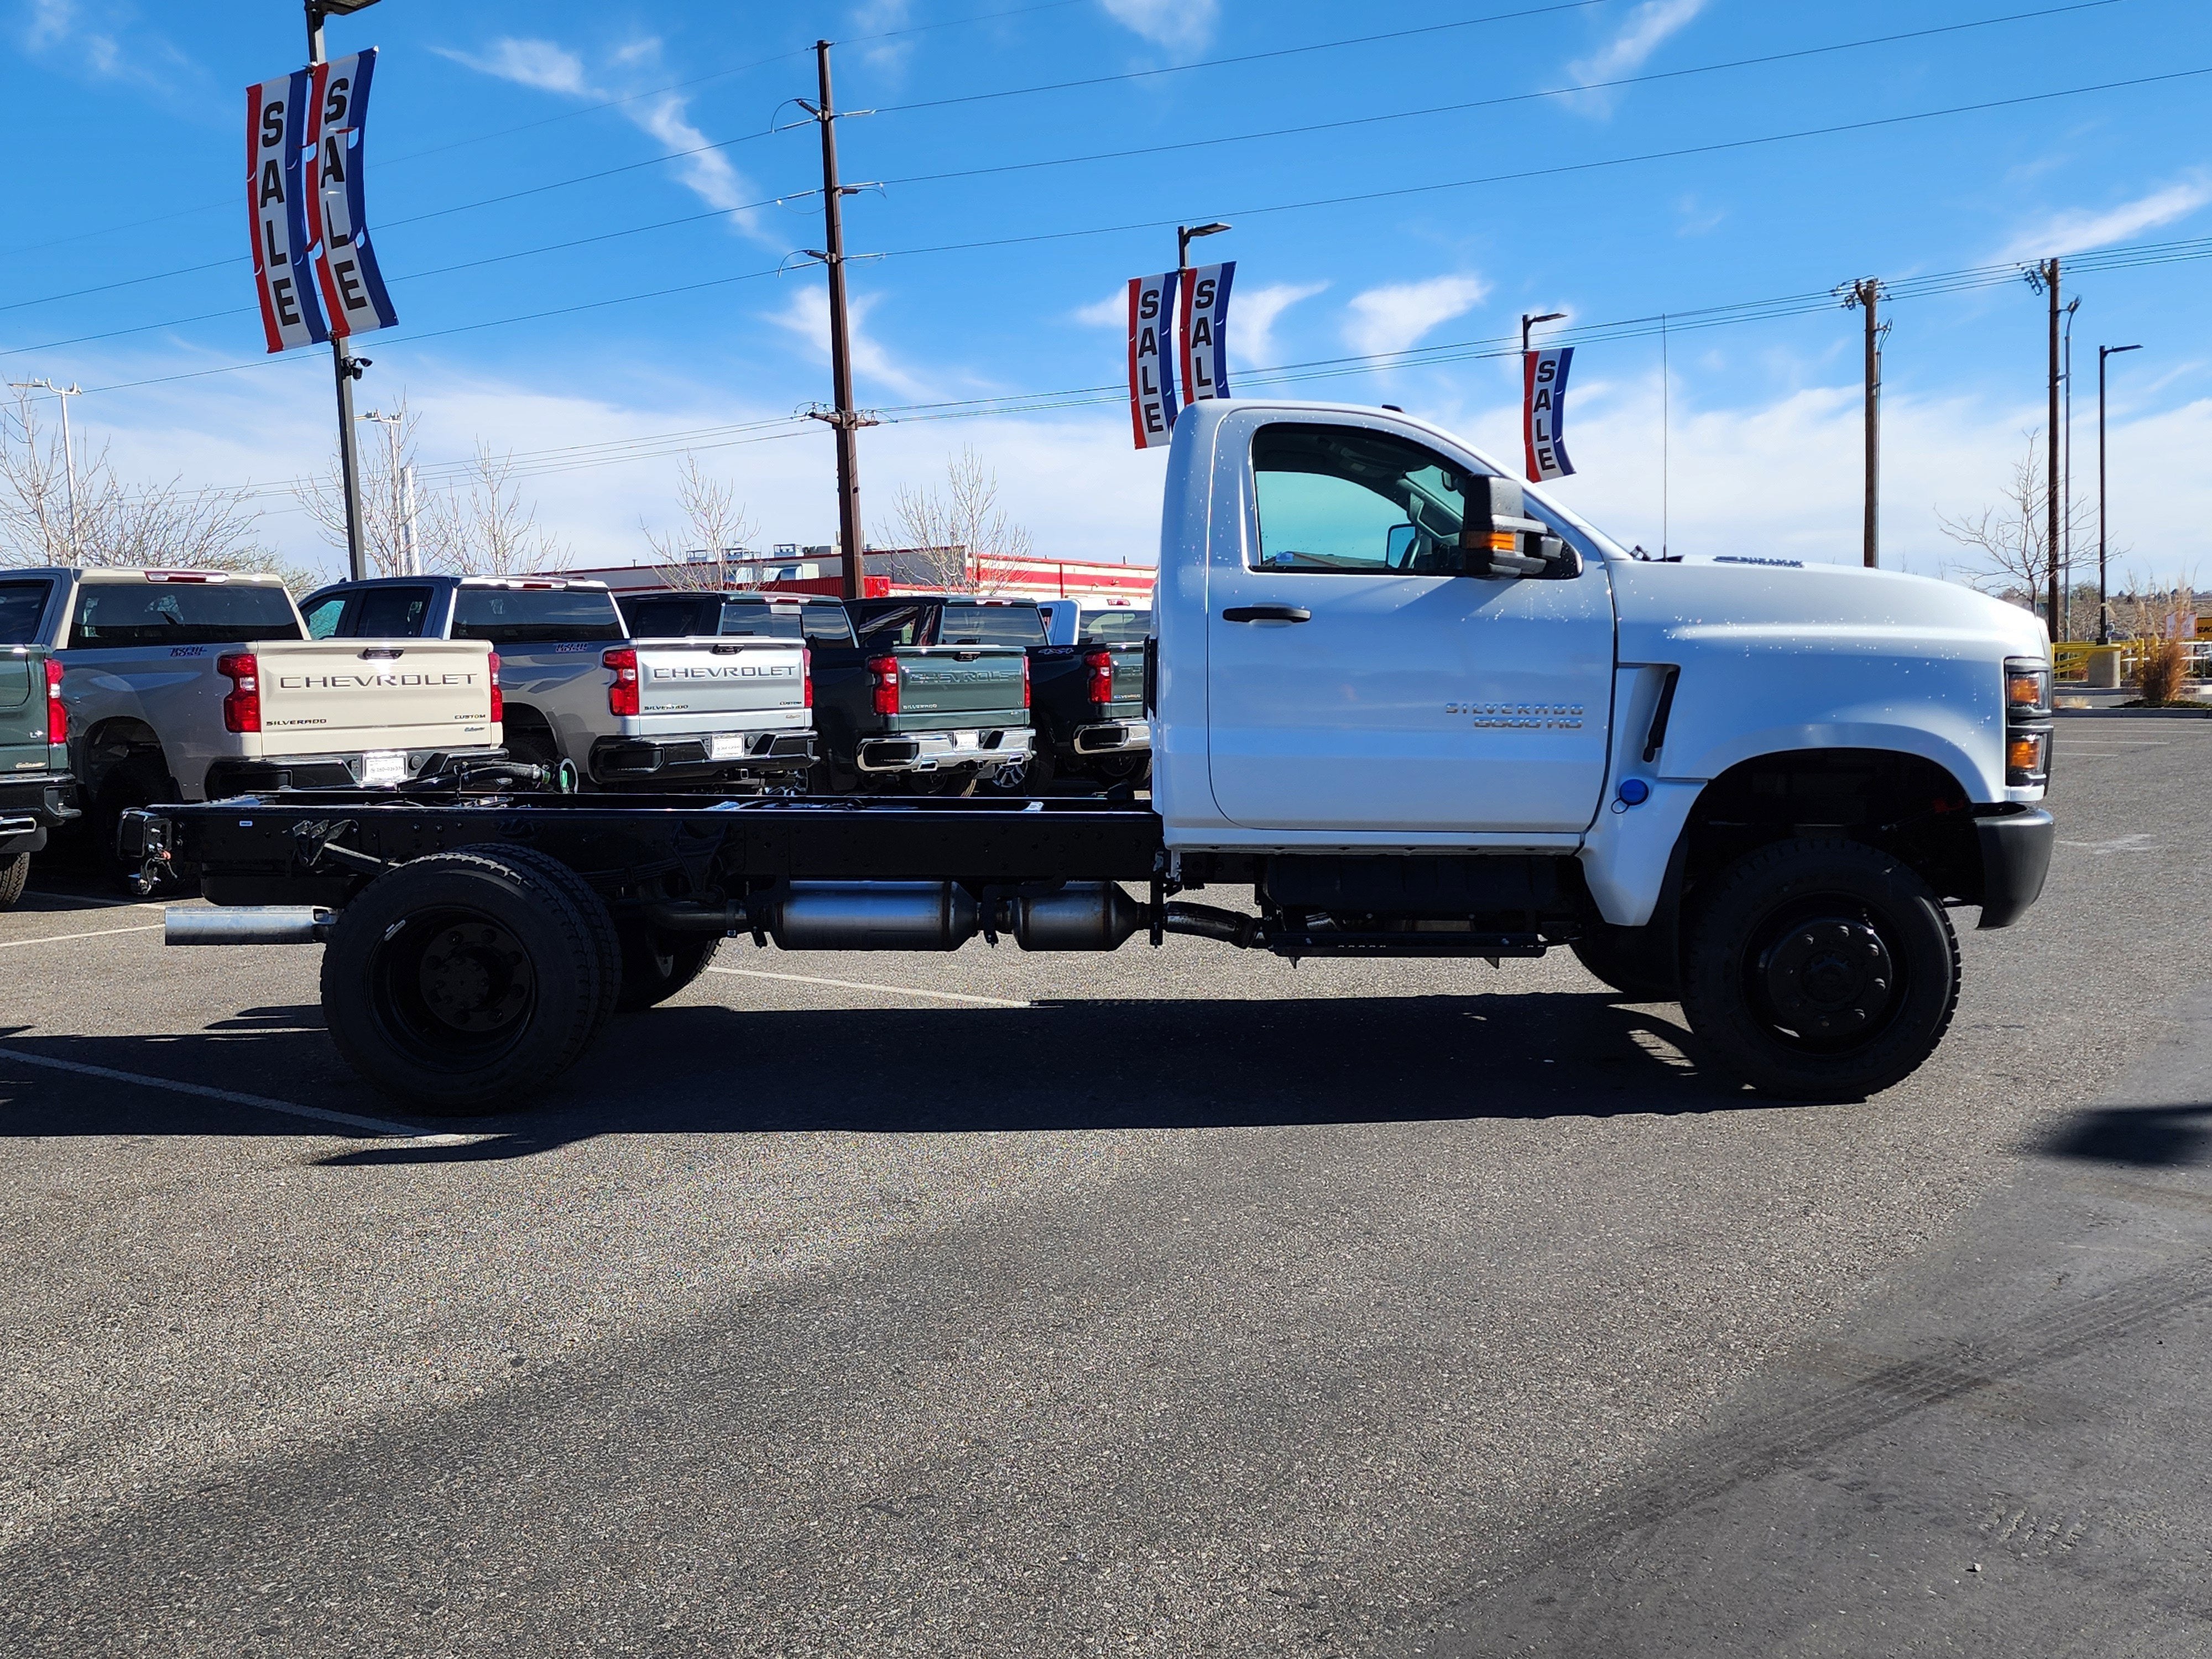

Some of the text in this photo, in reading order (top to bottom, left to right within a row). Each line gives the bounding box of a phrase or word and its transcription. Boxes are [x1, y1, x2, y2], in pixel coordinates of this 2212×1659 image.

[260, 100, 300, 326] SALE
[320, 78, 368, 311] SALE
[1138, 289, 1164, 434] SALE
[1192, 279, 1216, 399] SAL
[1533, 360, 1557, 471] SALE
[280, 673, 477, 688] CHEVROLET
[654, 666, 796, 679] CHEVROLET
[910, 670, 1020, 684] CHEVROLET
[1446, 703, 1584, 715] SILVERADO
